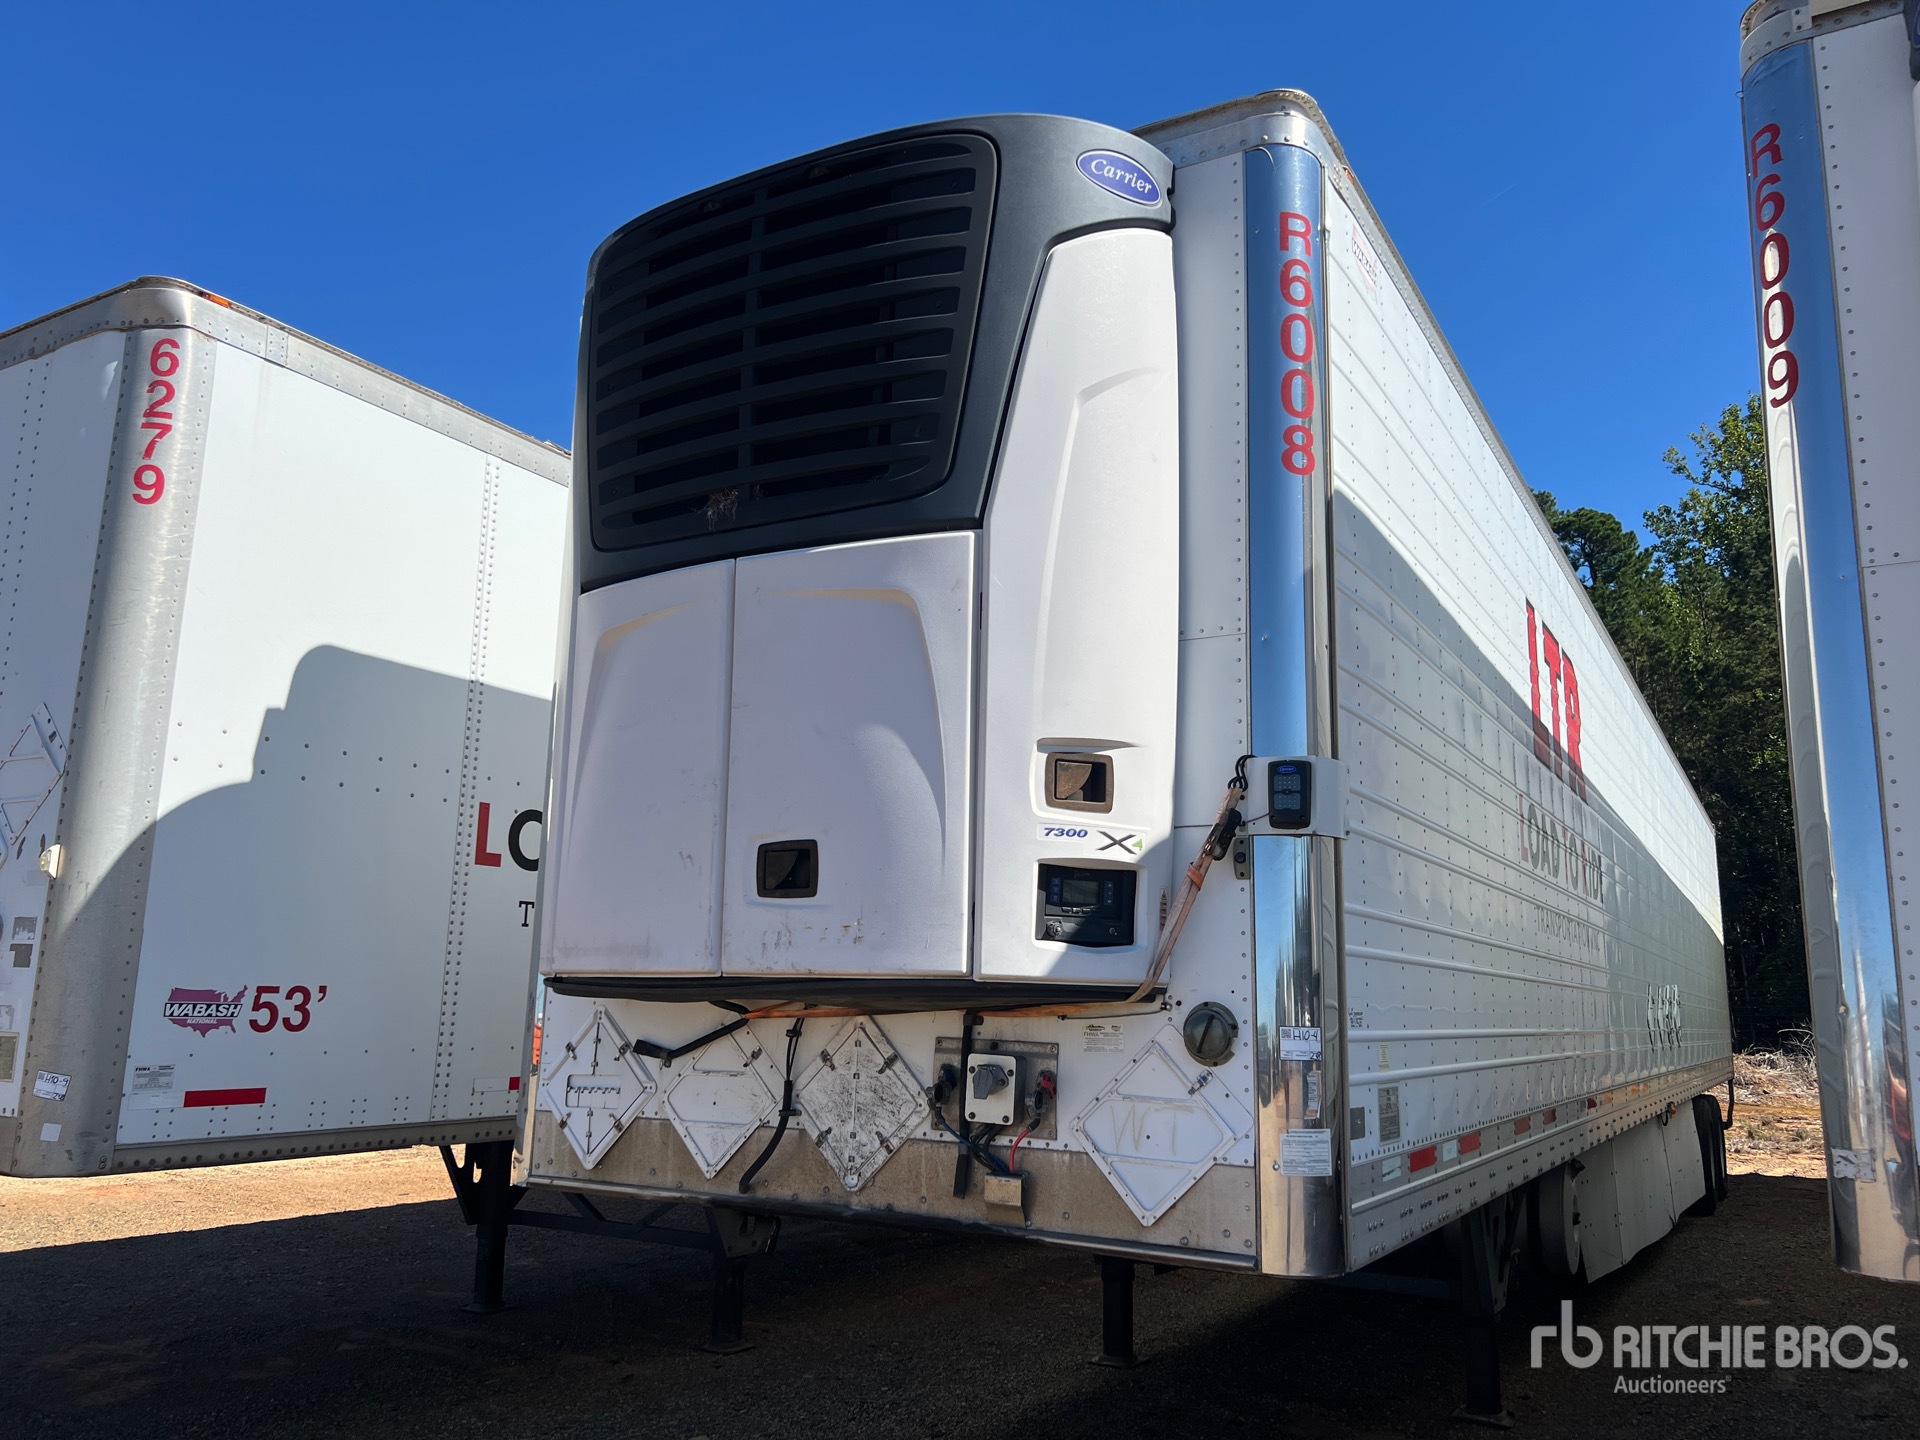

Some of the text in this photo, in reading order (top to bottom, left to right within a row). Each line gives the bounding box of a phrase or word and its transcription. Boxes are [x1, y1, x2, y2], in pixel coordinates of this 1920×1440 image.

[1090, 159, 1153, 195] Carrier
[1751, 123, 1799, 409] R6009
[1279, 211, 1316, 476] R6008
[132, 338, 180, 505] 6279
[1525, 597, 1590, 806] LTR
[1044, 827, 1088, 838] 7300
[1519, 793, 1604, 904] LOAD TO RID
[164, 1003, 243, 1017] WABASH
